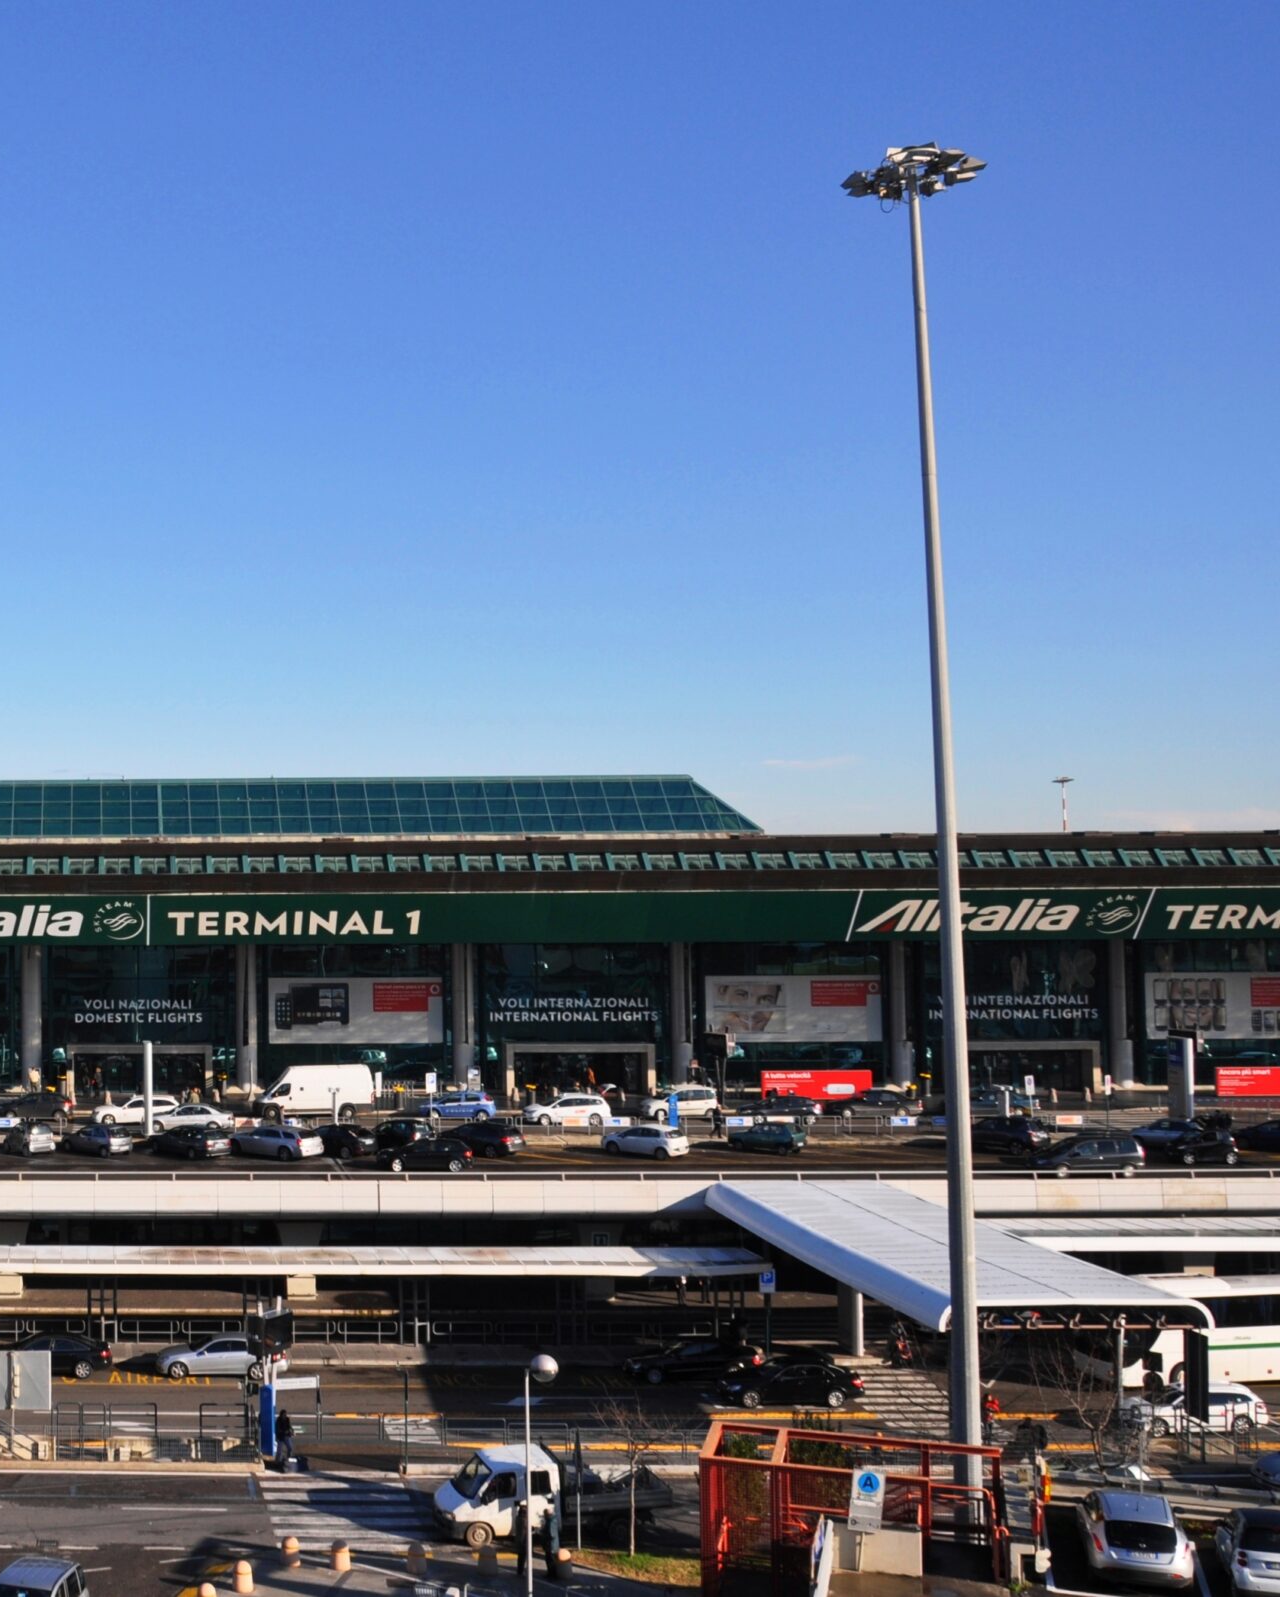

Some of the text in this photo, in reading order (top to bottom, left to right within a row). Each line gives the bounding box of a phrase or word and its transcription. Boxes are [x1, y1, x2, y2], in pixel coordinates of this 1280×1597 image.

[93, 900, 132, 933] SKYTEAM
[1085, 894, 1134, 927] SKYTEAM
[167, 909, 421, 936] TERMINAL 1
[1165, 904, 1280, 930] TERM
[83, 999, 192, 1011] VOLI NAZIONALI
[498, 997, 649, 1009] VOLI INTERNAZIONALI
[972, 994, 1089, 1006] INTERNAZIONALI
[74, 1012, 203, 1024] DOMESTIC FLIGHTS
[489, 1011, 658, 1023] INTERNATIONAL FLIGHTS
[1042, 1008, 1099, 1020] FLIGHTS
[862, 1476, 875, 1489] A
